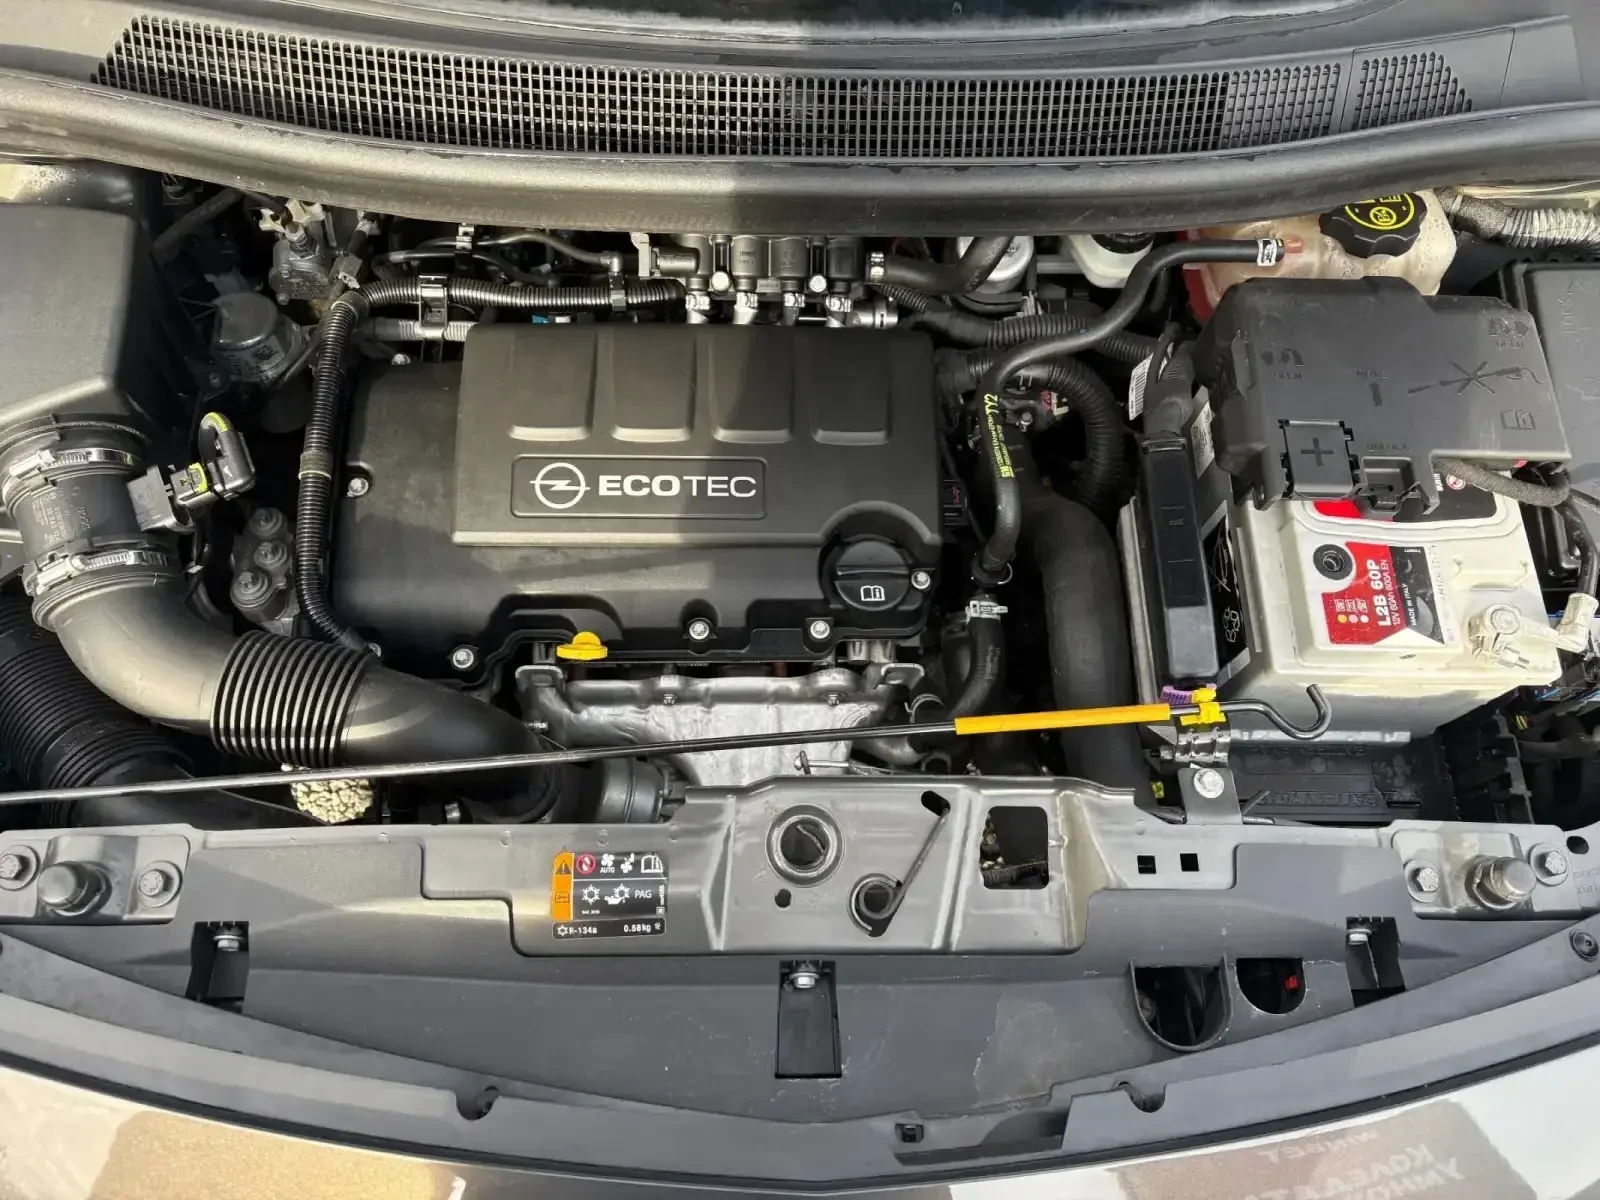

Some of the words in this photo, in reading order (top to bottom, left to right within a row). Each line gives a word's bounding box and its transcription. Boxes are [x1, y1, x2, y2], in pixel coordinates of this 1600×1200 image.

[598, 474, 757, 498] ECOTEC
[1367, 559, 1384, 590] 60P
[1401, 583, 1412, 599] ITALY
[1373, 594, 1392, 626] L2B
[1406, 599, 1413, 607] IN
[1407, 607, 1417, 626] MADE
[600, 866, 616, 874] AUTO
[634, 889, 652, 899] PAG
[568, 926, 598, 935] R-134a
